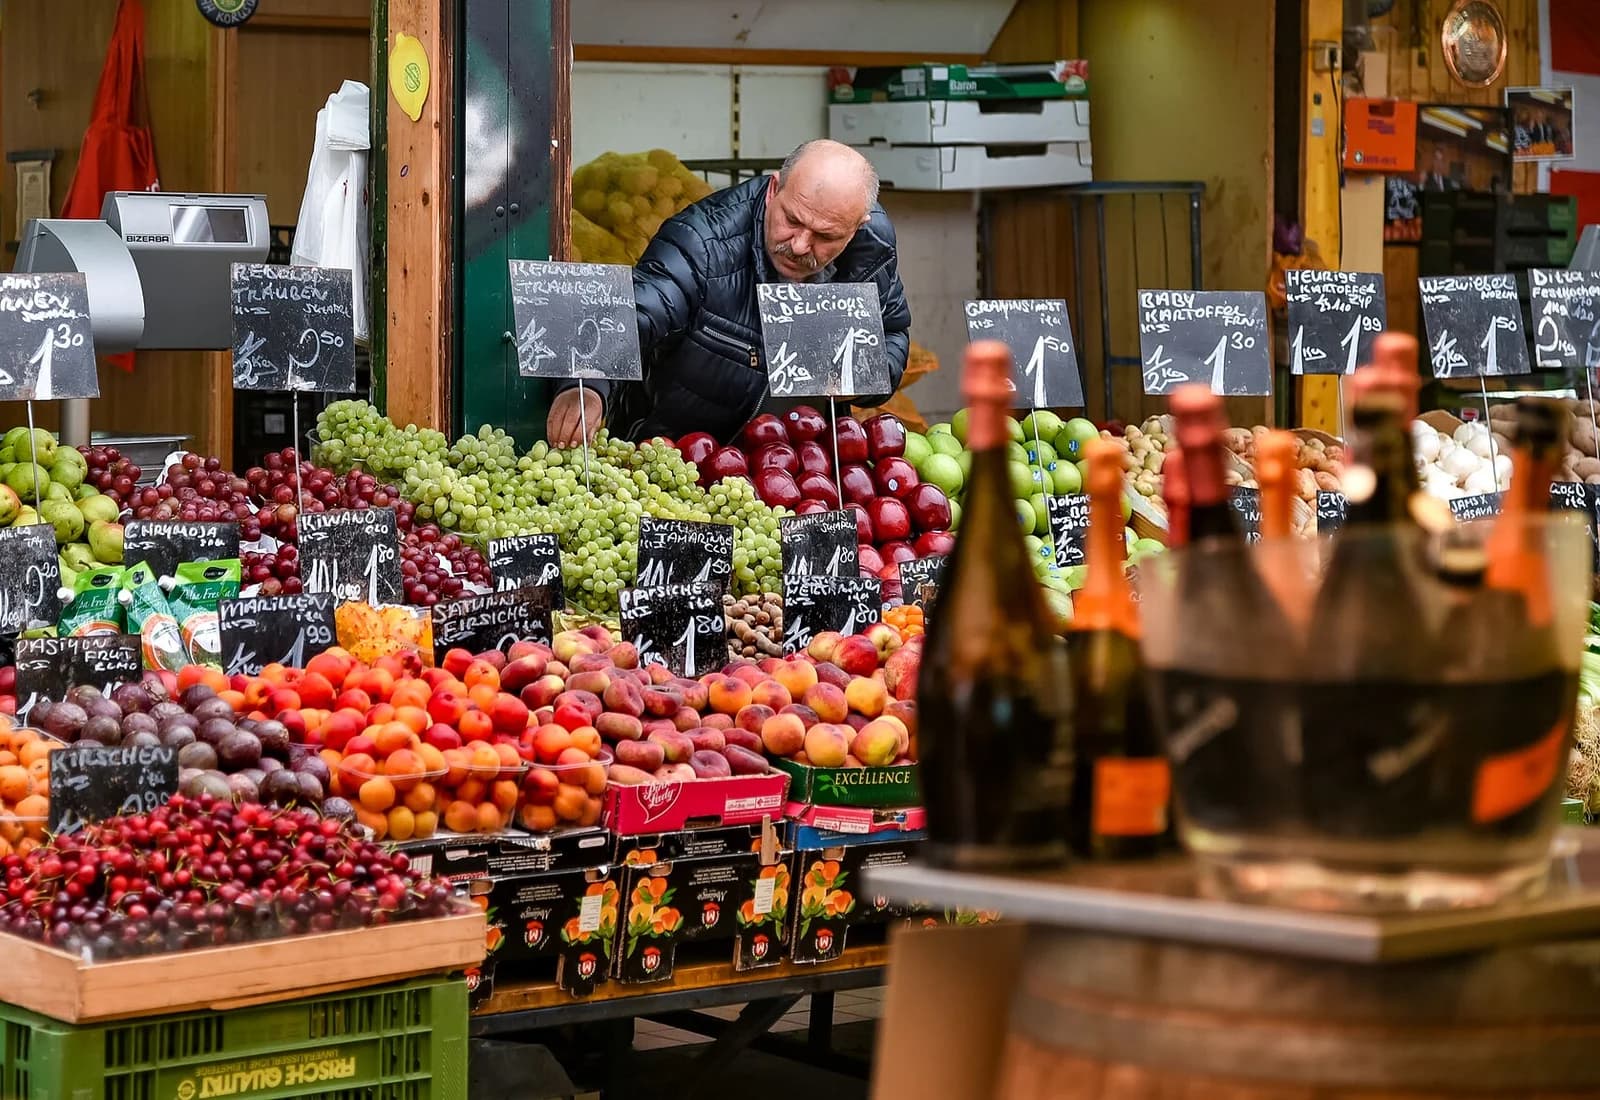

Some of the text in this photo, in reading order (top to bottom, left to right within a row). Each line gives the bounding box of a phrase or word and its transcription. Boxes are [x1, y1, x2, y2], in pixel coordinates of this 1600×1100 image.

[950, 80, 977, 91] Baron
[126, 235, 169, 243] BIZERBA
[1533, 268, 1584, 286] Ditta
[759, 283, 802, 302] RED
[1140, 292, 1195, 309] BABY
[780, 294, 866, 316] DELICIOUS
[302, 510, 376, 531] KIWANO
[432, 594, 514, 623] SATURN
[51, 745, 173, 776] KIRSCHEN
[835, 771, 911, 785] EXCELLENCE
[285, 1057, 356, 1086] FRISCHE
